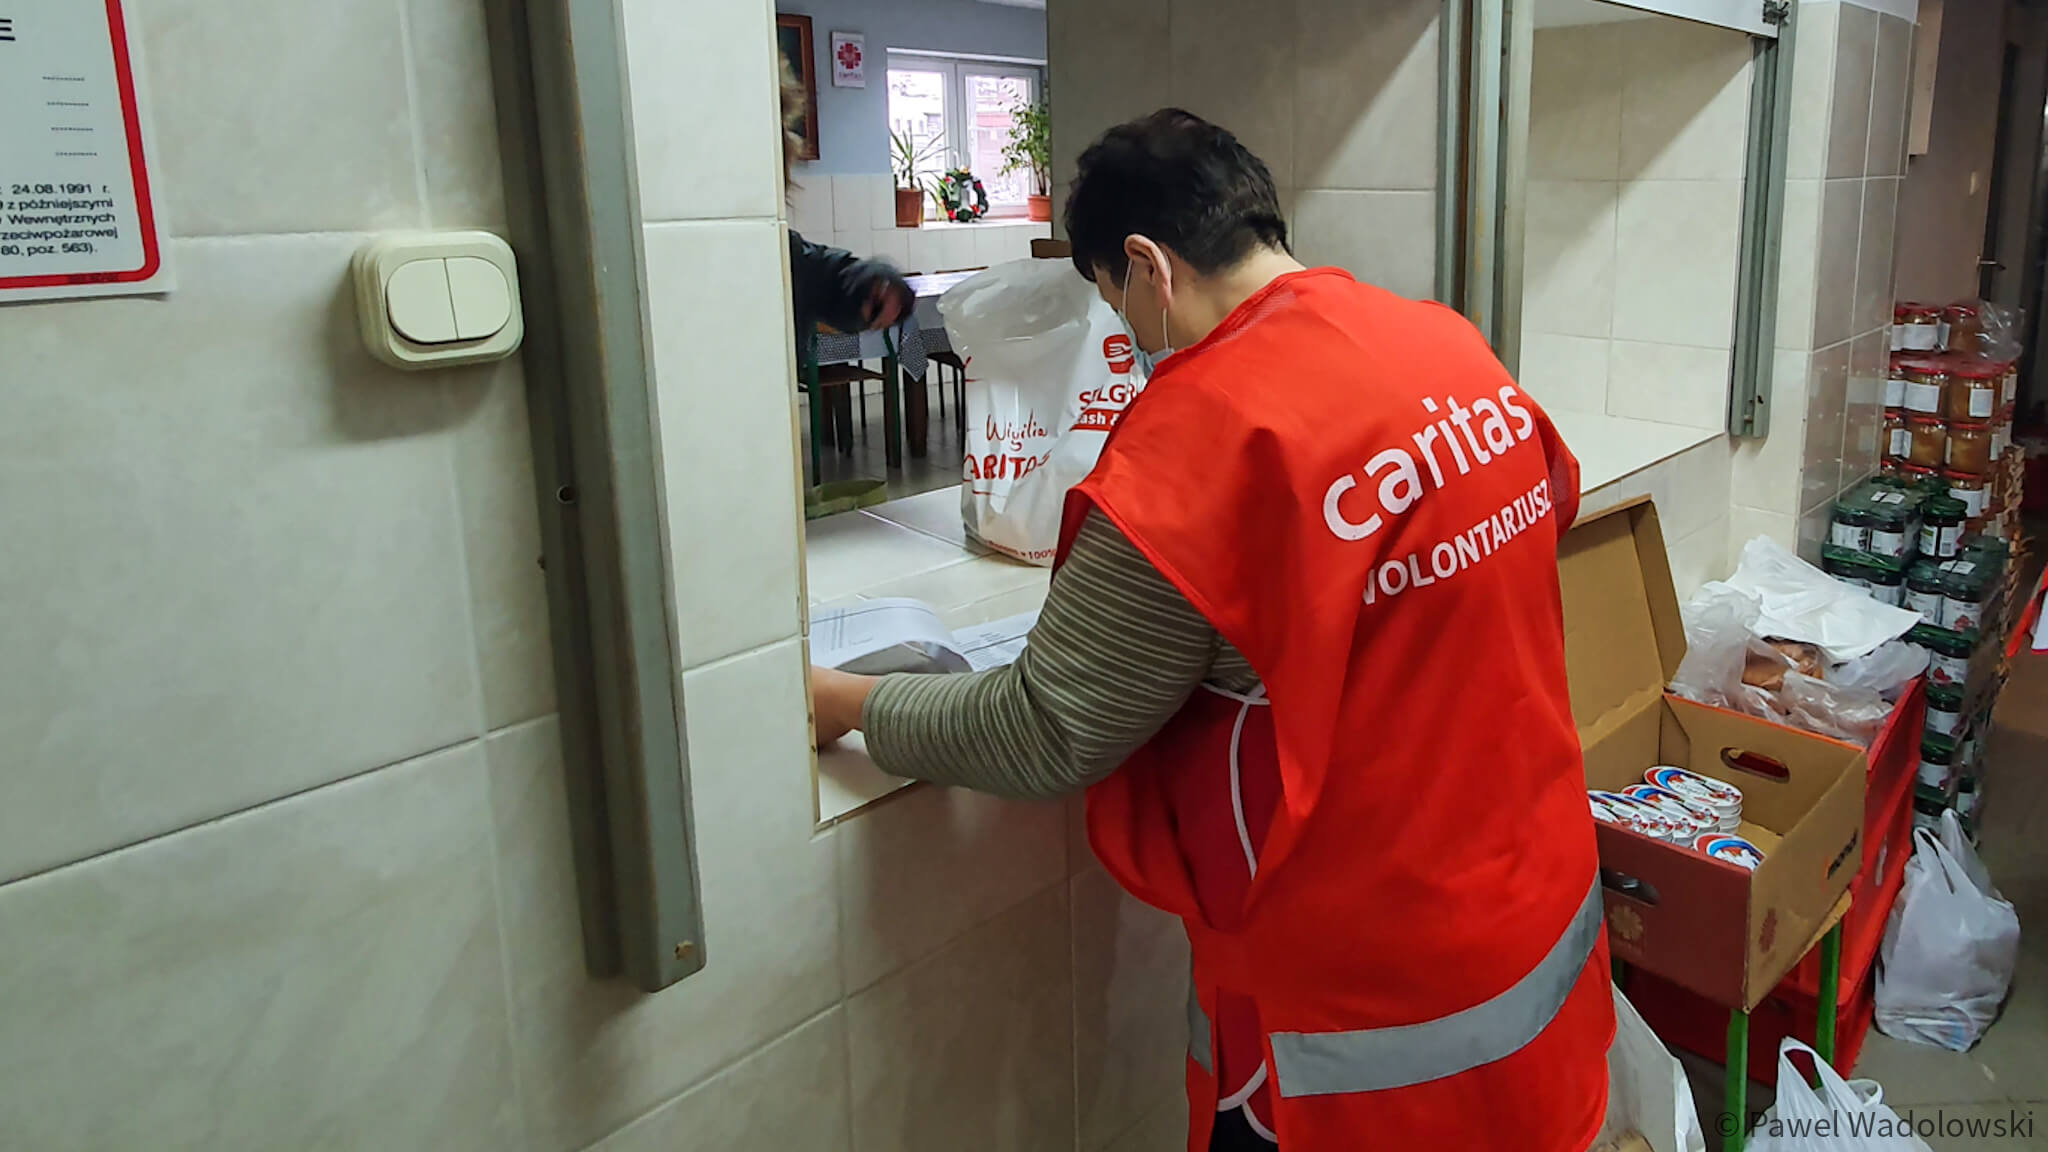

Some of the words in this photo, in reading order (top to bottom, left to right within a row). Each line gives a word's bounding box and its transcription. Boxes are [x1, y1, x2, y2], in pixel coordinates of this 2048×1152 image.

[12, 184, 92, 195] 24.08.1991
[102, 185, 111, 193] r.
[7, 202, 16, 210] z
[19, 198, 114, 211] późniejszymi
[8, 213, 116, 226] Wewnętrznych
[1078, 411, 1107, 425] ash
[986, 408, 1049, 452] Wigilia
[1322, 385, 1534, 541] caritas
